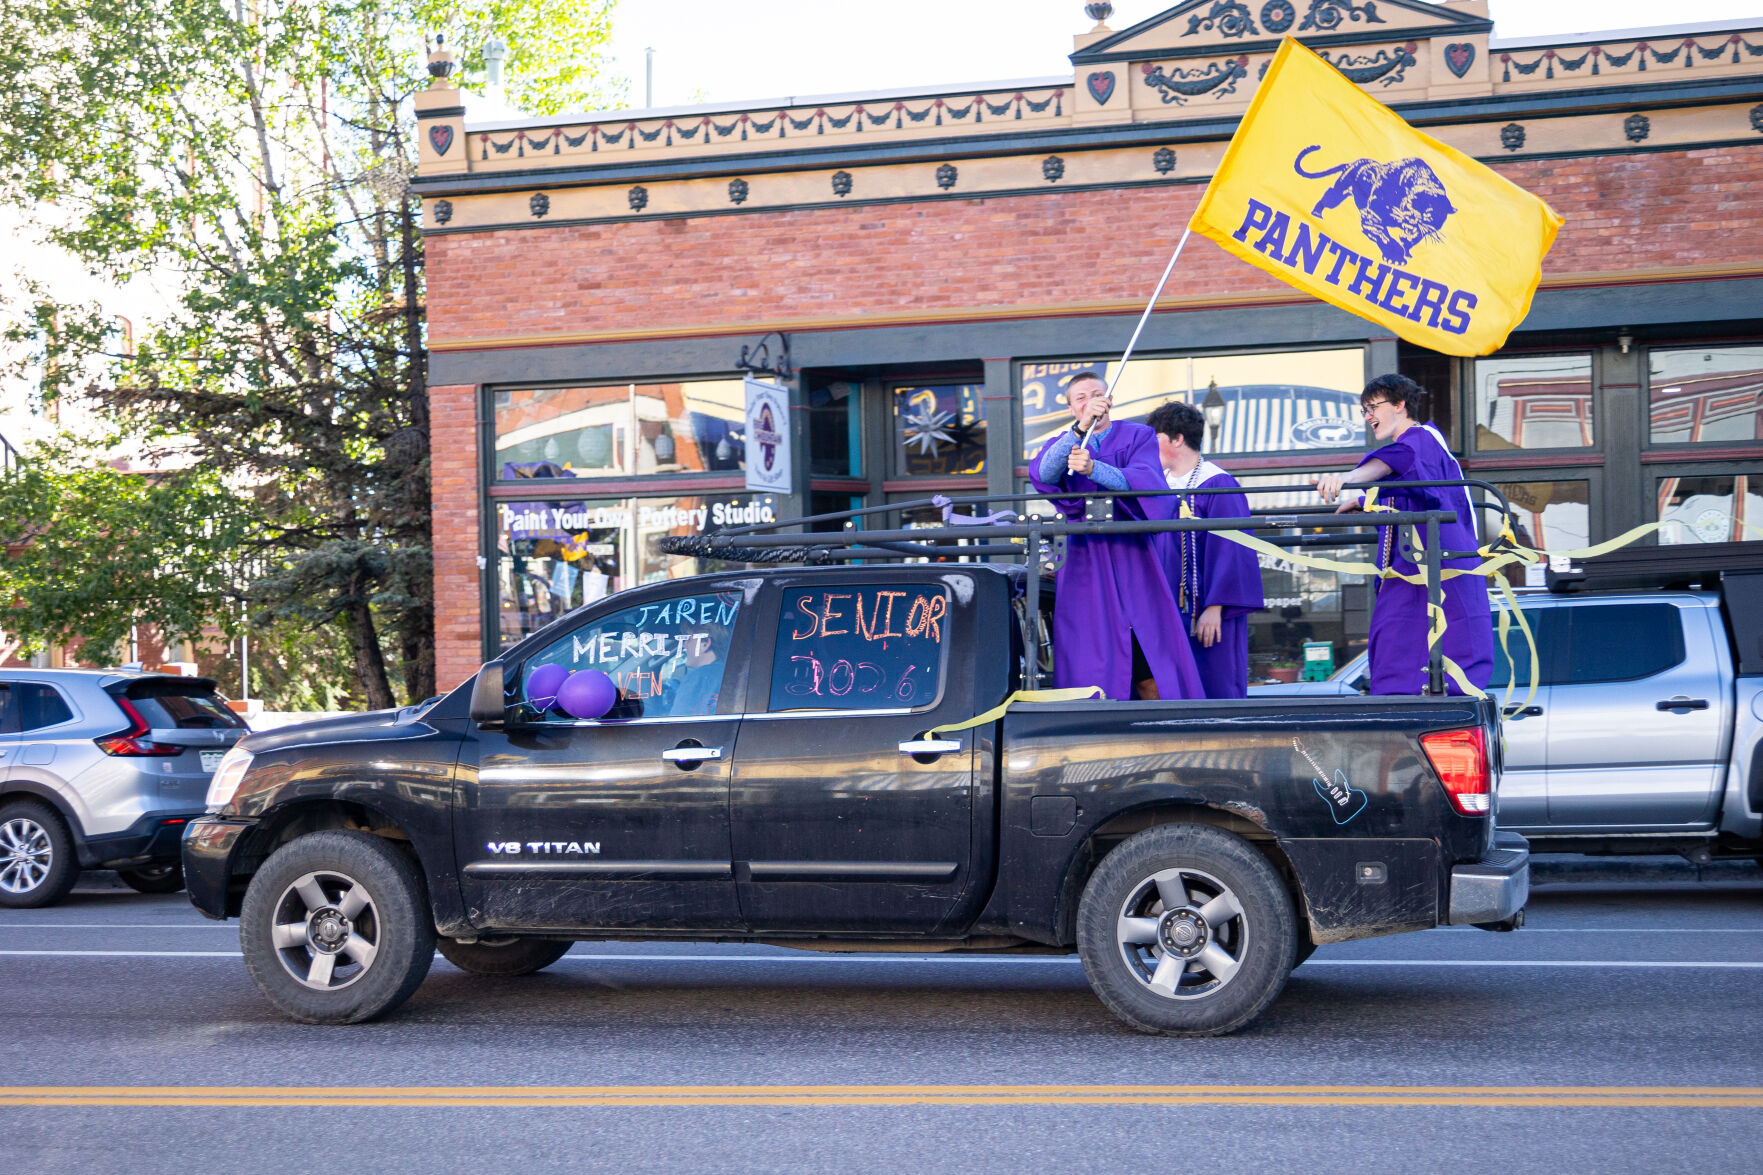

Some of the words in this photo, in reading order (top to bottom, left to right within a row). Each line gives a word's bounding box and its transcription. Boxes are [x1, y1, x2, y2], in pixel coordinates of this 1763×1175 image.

[1232, 198, 1478, 335] PANTHERS
[503, 506, 548, 530] Paint
[551, 507, 588, 530] Your
[639, 505, 707, 530] Pottery
[712, 502, 773, 525] Studio
[635, 598, 740, 627] JAREN
[792, 590, 946, 643] SENIOR
[572, 631, 709, 664] MERRITT
[603, 670, 663, 701] VIN
[486, 841, 521, 854] V8
[526, 841, 600, 854] TITAN
